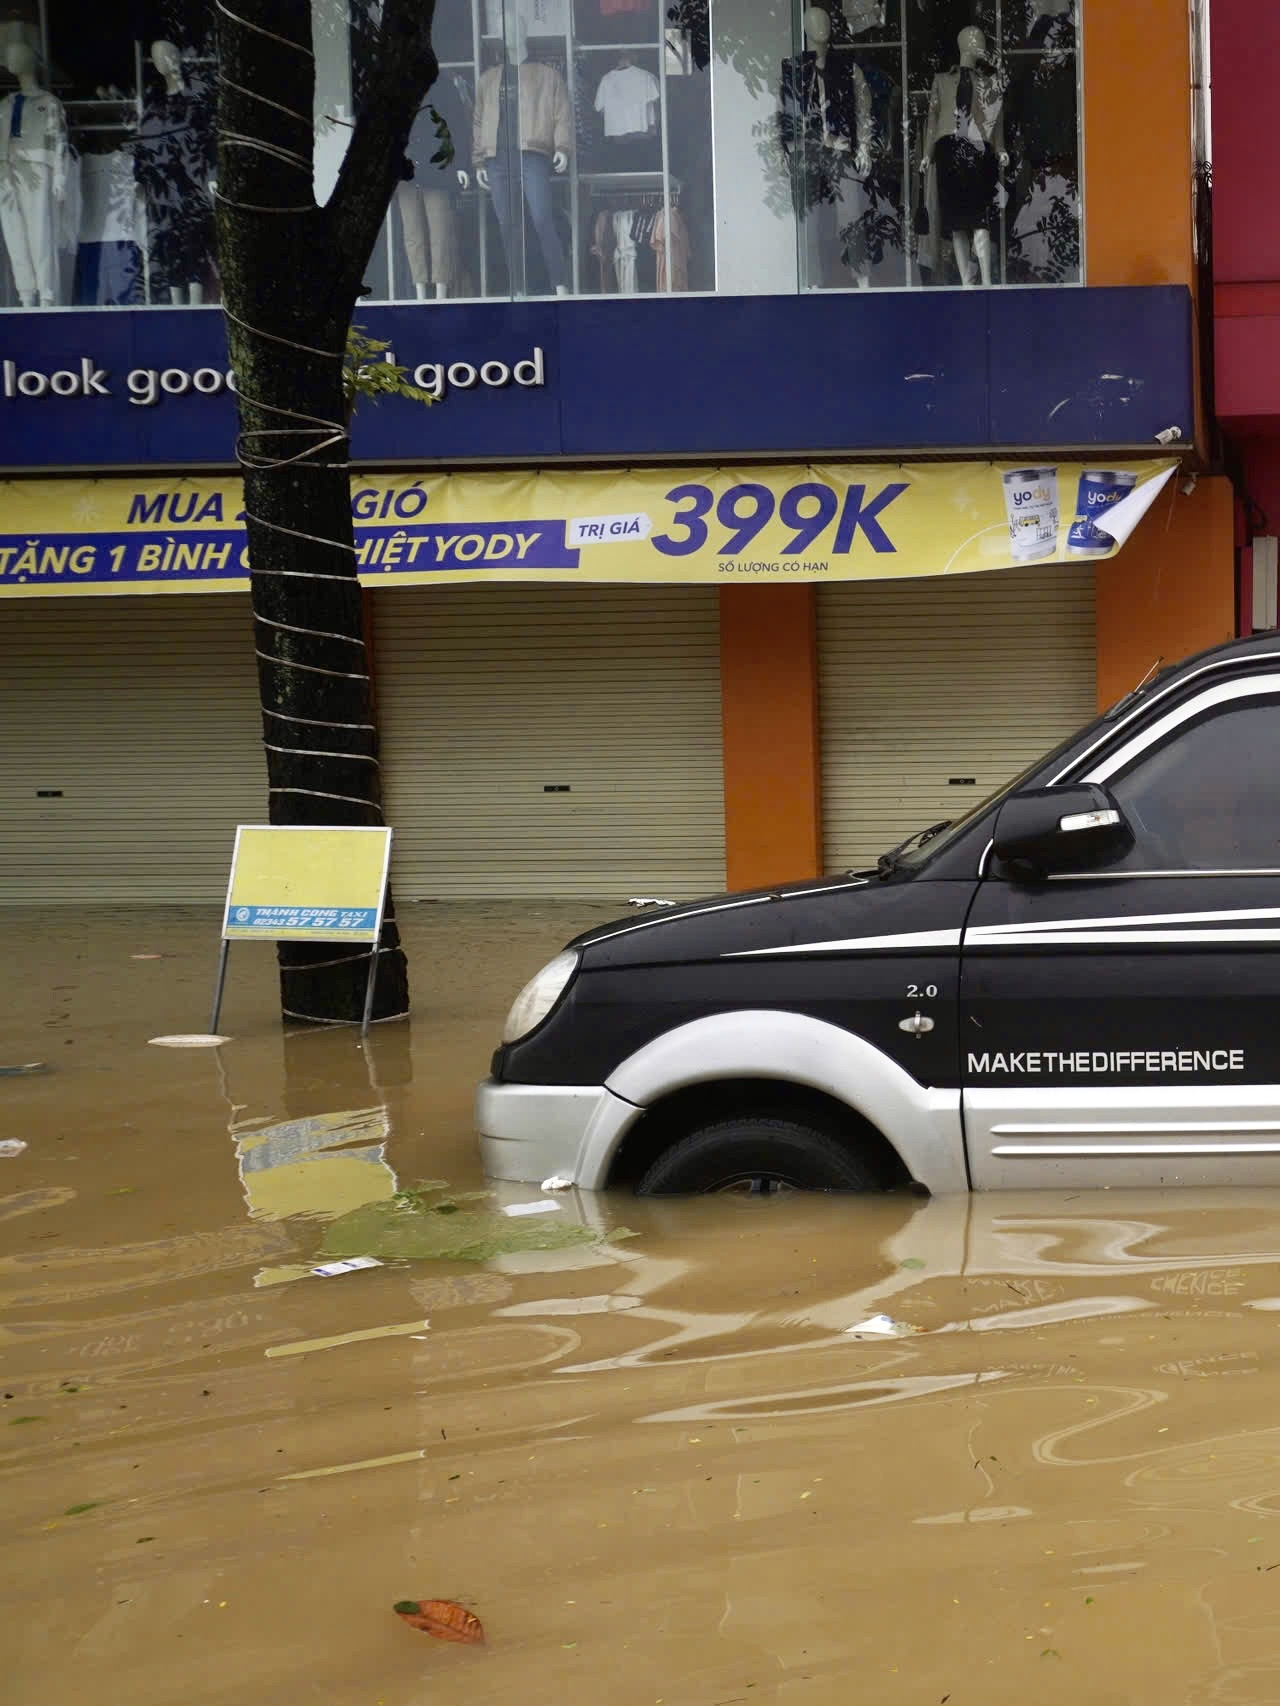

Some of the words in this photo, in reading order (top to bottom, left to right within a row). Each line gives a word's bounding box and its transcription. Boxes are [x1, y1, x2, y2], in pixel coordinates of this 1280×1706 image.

[3, 357, 112, 397] look
[413, 346, 545, 397] good
[127, 492, 224, 525] MUA
[350, 480, 428, 520] GIÓ
[1013, 485, 1051, 506] yody
[578, 524, 605, 540] TRỊ
[609, 518, 641, 535] GIÁ
[650, 482, 912, 557] 399K
[0, 539, 97, 583] TẶNG
[109, 545, 127, 573] 1
[136, 536, 233, 572] BÌNH
[353, 530, 430, 572] HIỆT
[434, 532, 542, 562] YODY
[718, 560, 735, 572] SỐ
[737, 561, 780, 575] LƯỢNG
[782, 560, 800, 572] CÓ
[803, 562, 829, 574] HẠN
[286, 917, 310, 926] 57
[311, 917, 338, 927] 57
[338, 918, 365, 927] 57
[906, 984, 938, 998] 2.0
